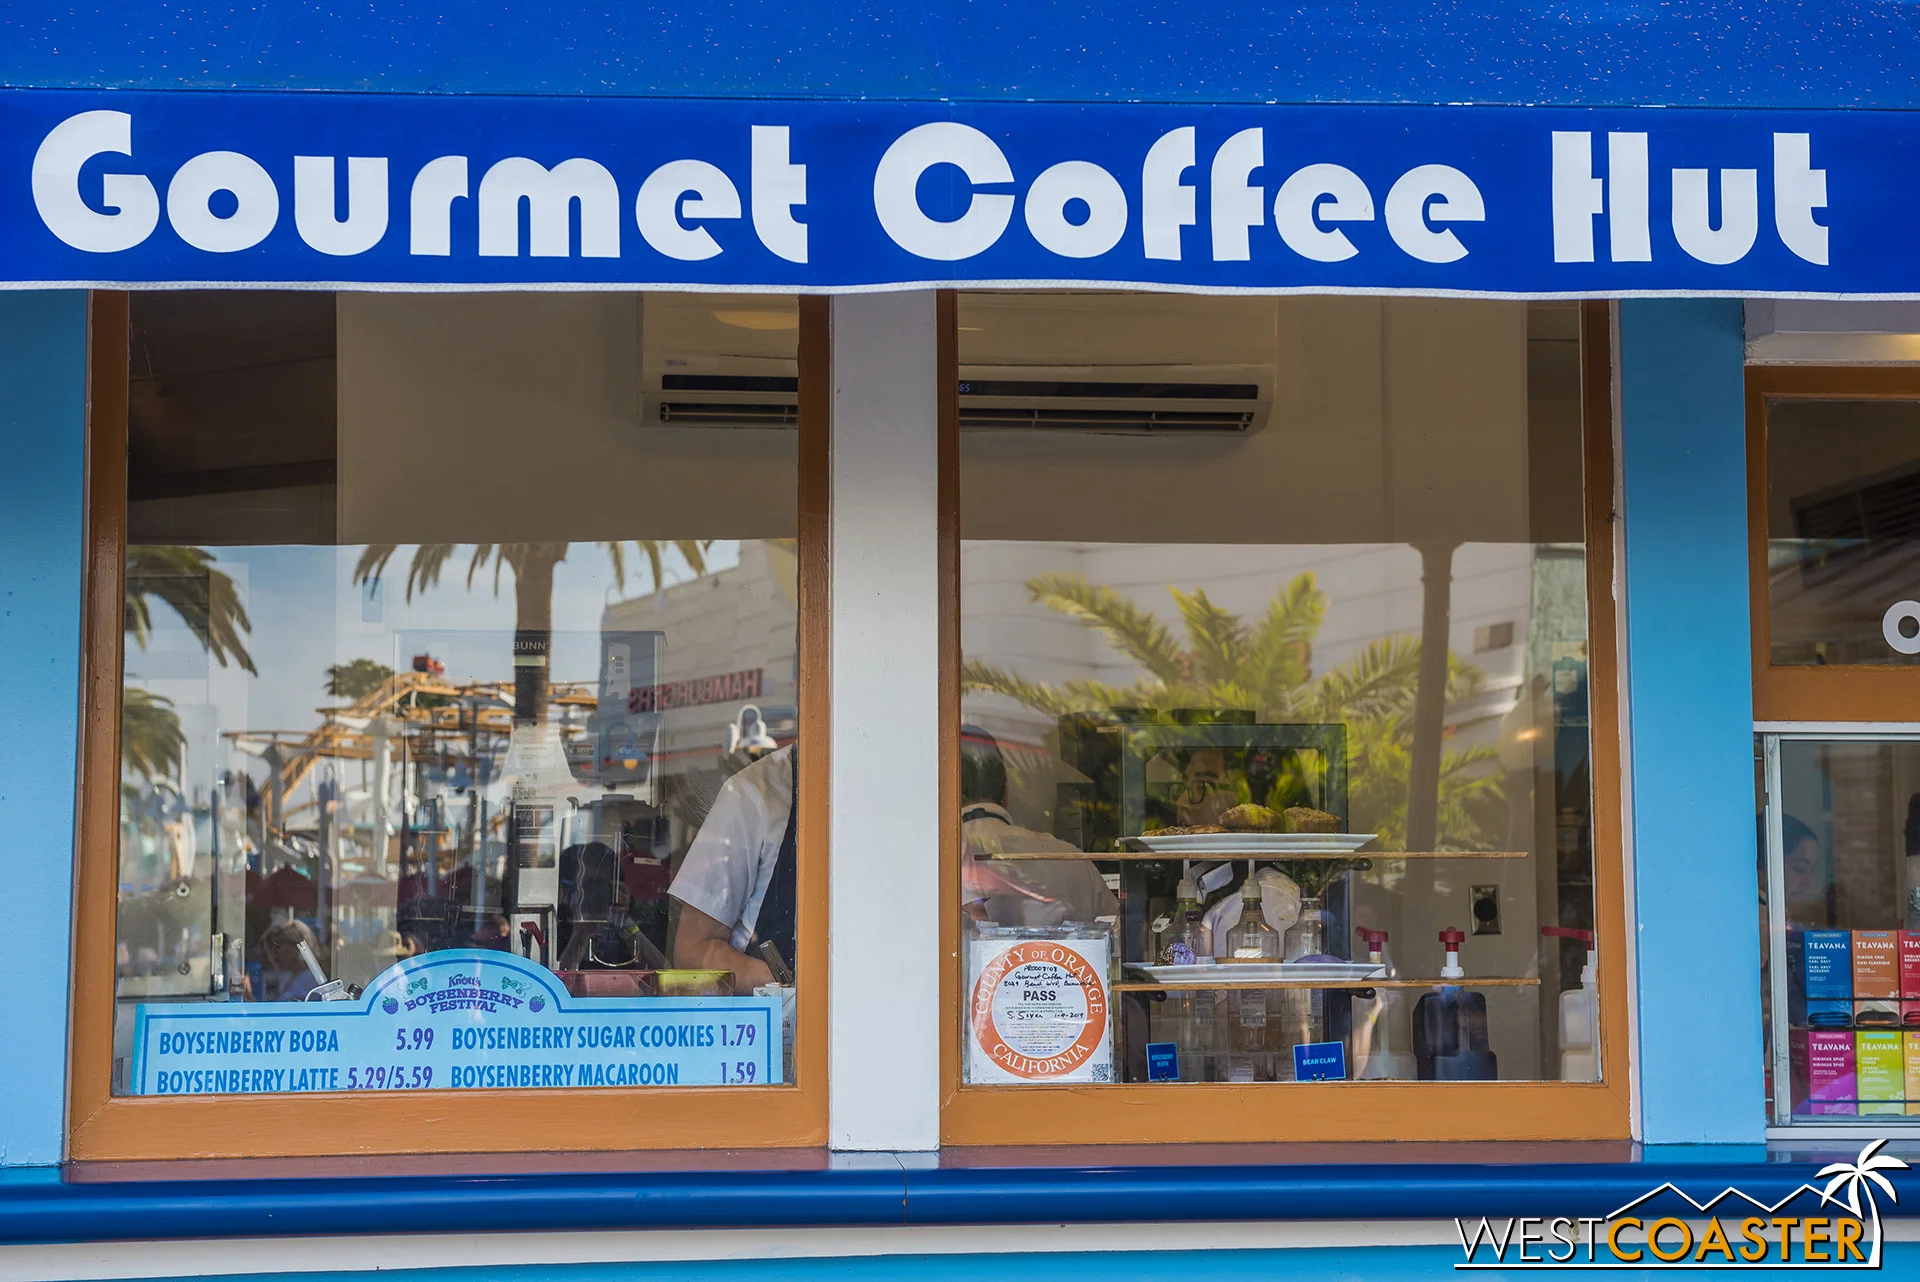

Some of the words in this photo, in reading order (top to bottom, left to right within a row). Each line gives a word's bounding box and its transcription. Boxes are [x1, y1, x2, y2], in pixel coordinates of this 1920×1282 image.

[32, 111, 807, 263] Gourmet
[874, 123, 1485, 262] Coffee
[1552, 132, 1828, 265] Hut
[513, 641, 546, 650] BUNN
[448, 974, 481, 988] Knott's
[976, 948, 1024, 1015] COUNTY
[1032, 950, 1047, 959] OF
[1052, 948, 1102, 1014] ORANGE
[404, 988, 524, 1012] BOYSENBERRY
[430, 1000, 497, 1014] FESTIVAL
[1024, 991, 1056, 1001] PASS
[160, 1030, 285, 1055] BOYSENBERRY
[289, 1030, 339, 1052] BOBA
[396, 1028, 434, 1050] 5.99
[452, 1027, 574, 1050] BOYSENBERRY
[578, 1026, 636, 1048] SUGAR
[640, 1025, 714, 1047] COOKIES
[721, 1024, 756, 1046] 1.79
[993, 1043, 1089, 1073] CALIFORNIA
[157, 1069, 285, 1094] BOYSENBERRY
[290, 1068, 338, 1090] LATTE
[348, 1066, 433, 1089] 5.29/5.59
[451, 1064, 574, 1088] BOYSENBERRY
[578, 1063, 678, 1085] MACAROON
[720, 1062, 756, 1084] 1.59
